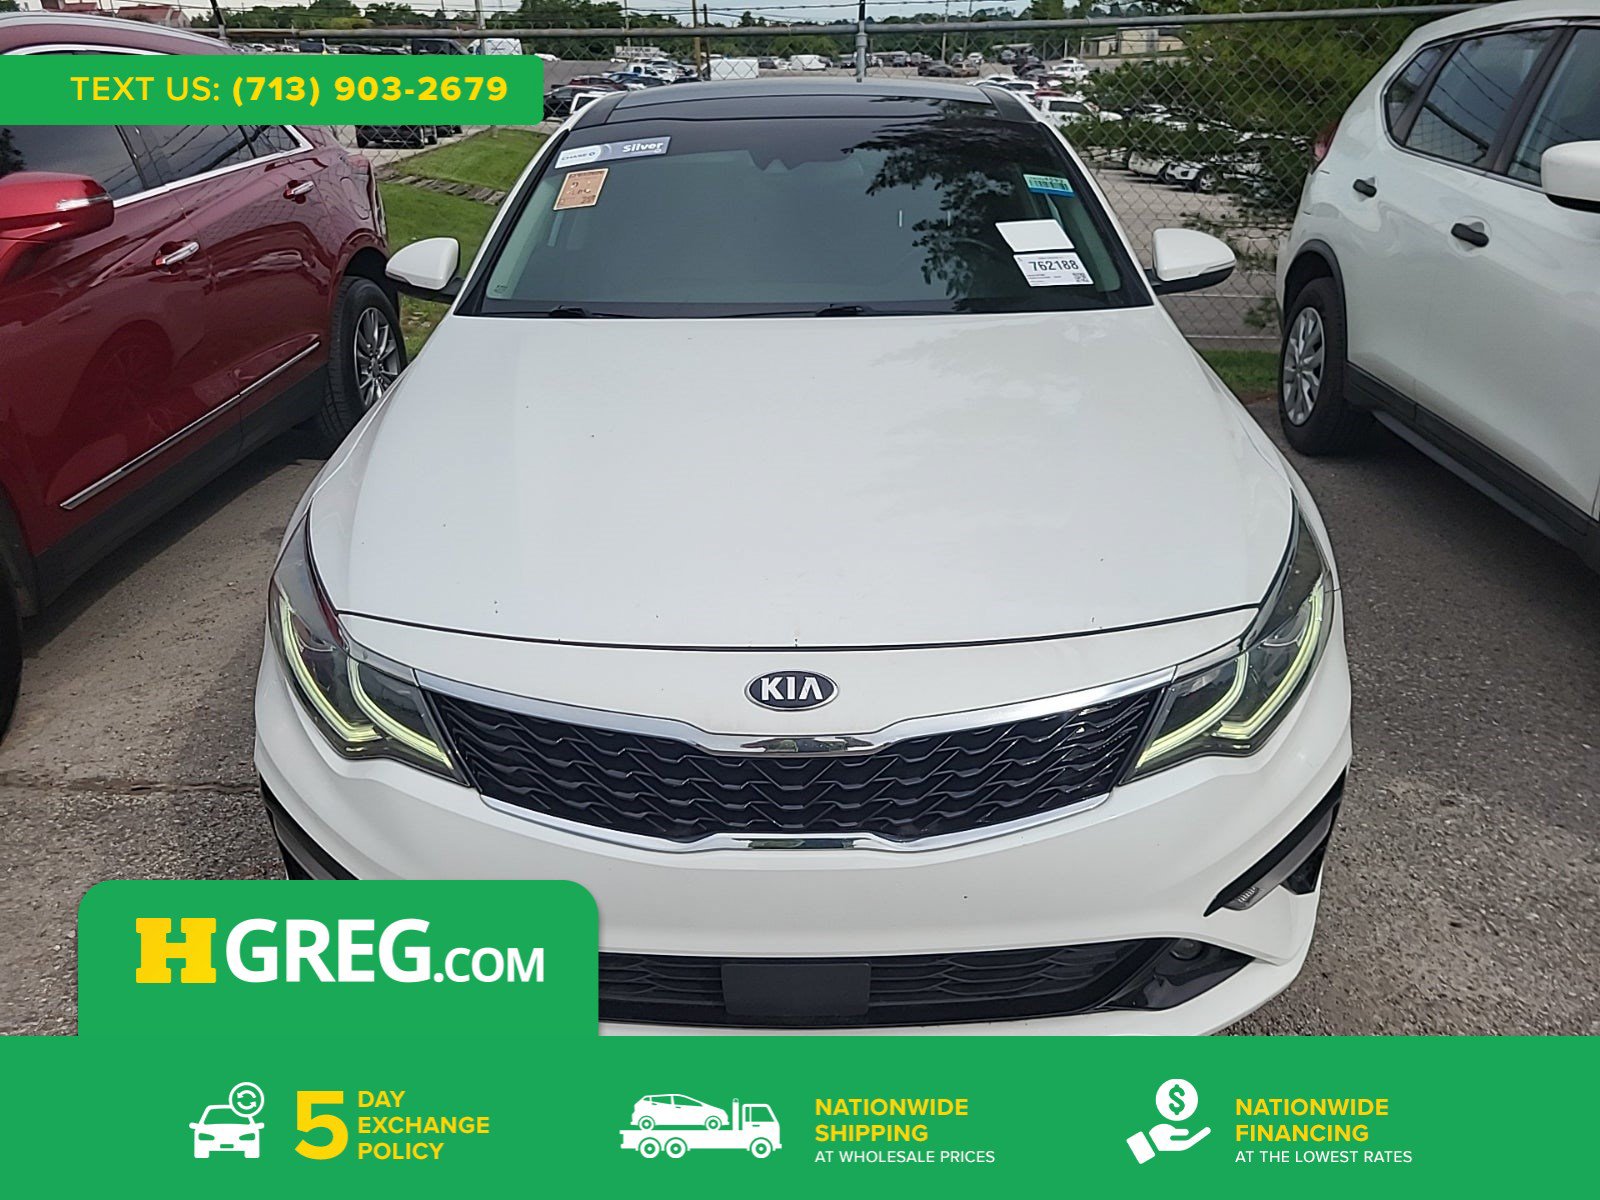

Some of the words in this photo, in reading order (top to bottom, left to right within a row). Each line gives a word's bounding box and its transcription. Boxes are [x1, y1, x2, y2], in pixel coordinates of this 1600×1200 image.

[622, 142, 664, 153] Silver
[1028, 260, 1079, 271] 762188
[760, 676, 823, 701] KIA
